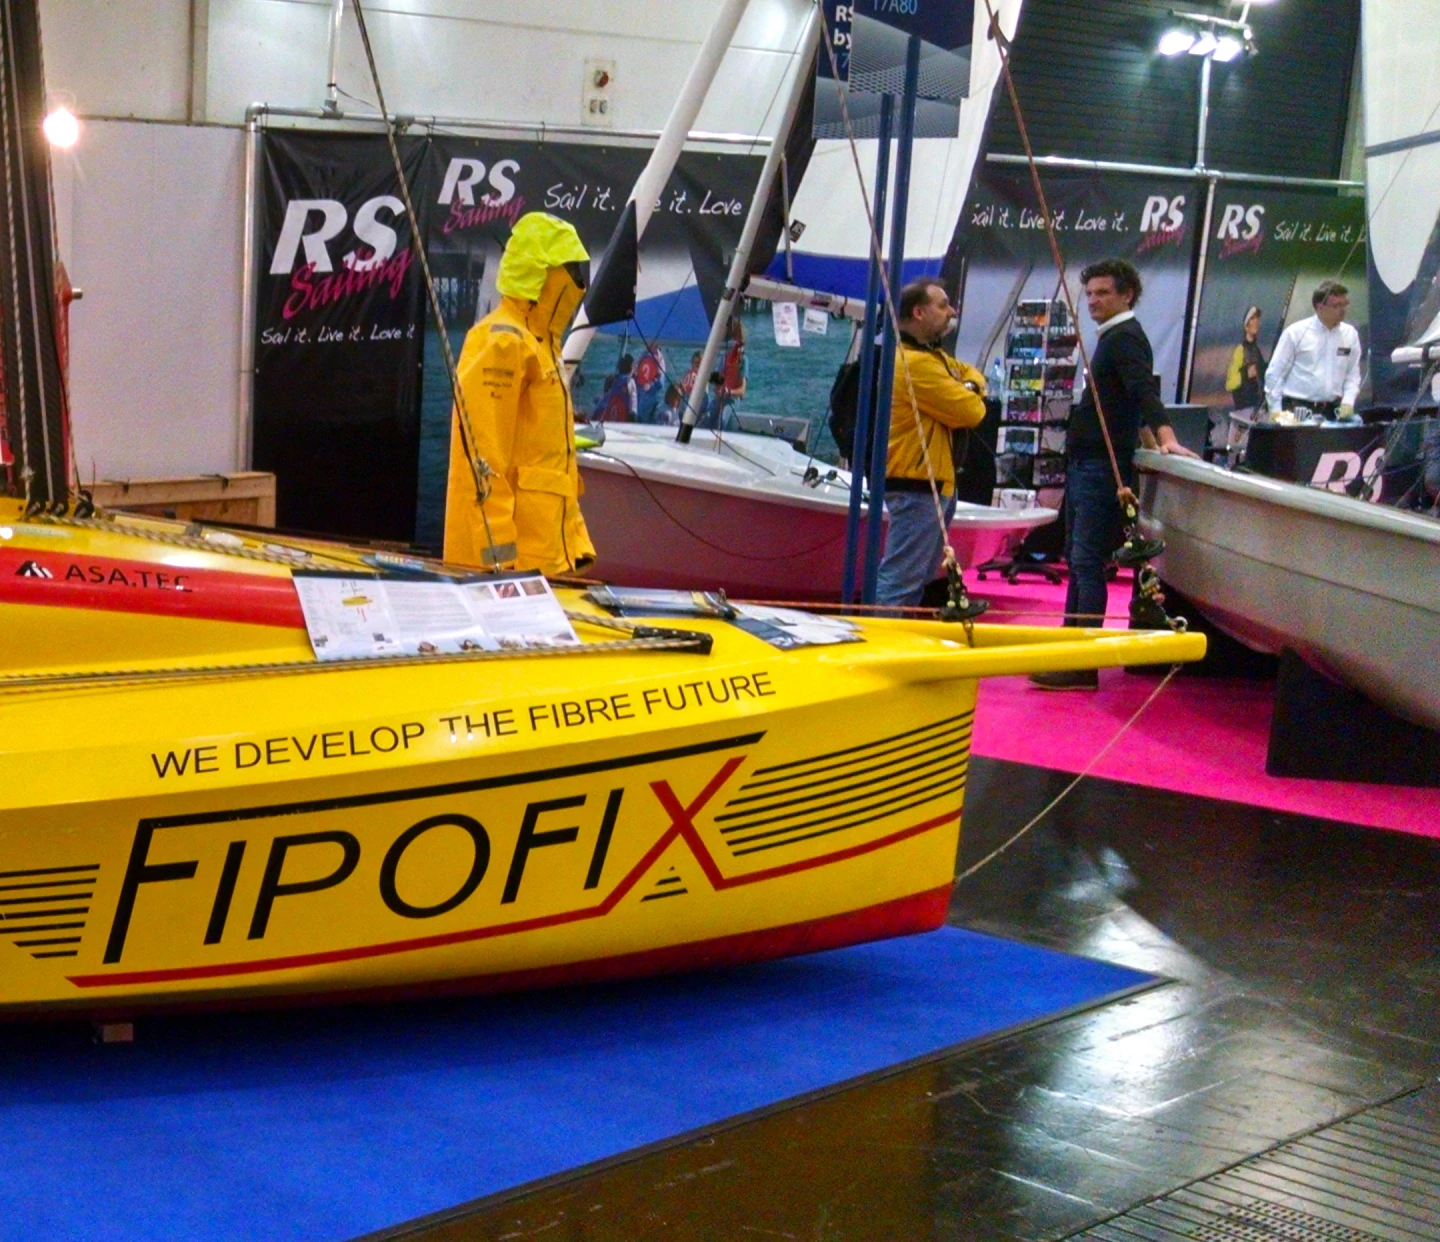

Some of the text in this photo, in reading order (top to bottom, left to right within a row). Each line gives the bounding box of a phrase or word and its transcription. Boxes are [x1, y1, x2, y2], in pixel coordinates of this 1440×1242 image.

[437, 157, 520, 207] RS
[544, 182, 588, 210] Sail
[593, 186, 616, 211] it.
[669, 190, 692, 214] it.
[699, 189, 742, 215] Love
[443, 192, 525, 234] Sailing
[999, 207, 1014, 228] it.
[1019, 207, 1044, 229] Live
[1075, 209, 1107, 231] Love
[1112, 210, 1129, 231] it.
[1139, 195, 1185, 232] RS
[1217, 204, 1265, 239] RS
[1273, 220, 1299, 241] Sail
[1315, 223, 1336, 242] Live
[269, 195, 406, 275] RS
[282, 247, 415, 320] Sailing
[261, 324, 291, 344] Sail
[294, 323, 311, 342] it.
[318, 325, 344, 342] Live
[348, 323, 364, 342] it.
[370, 323, 402, 341] Love
[65, 564, 193, 593] ASA.TEC
[150, 671, 777, 779] WE DEVELOP THE FIBRE FUTURE
[102, 754, 749, 965] FIPOFIX
